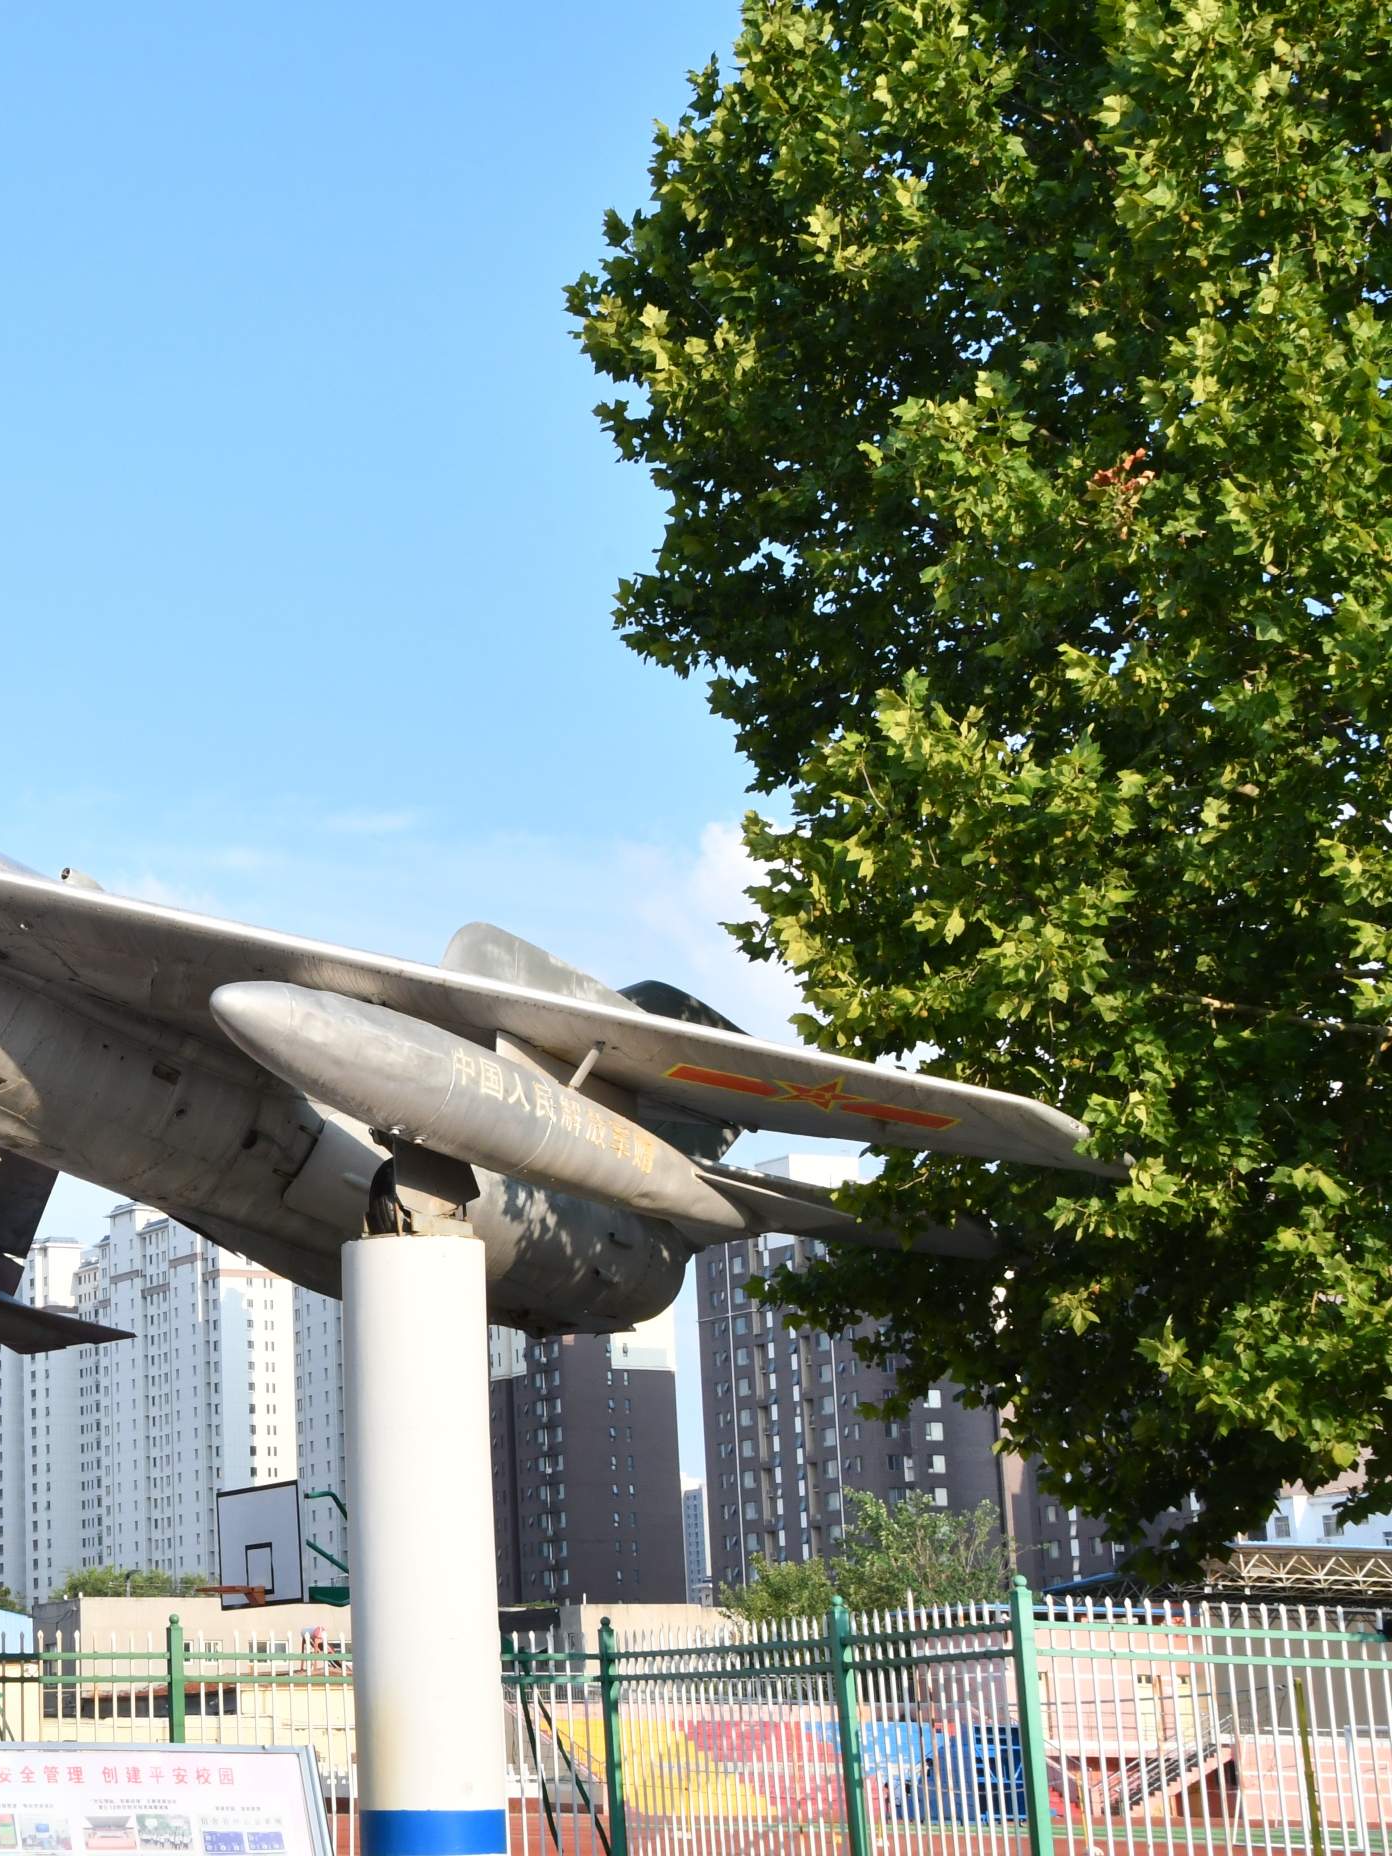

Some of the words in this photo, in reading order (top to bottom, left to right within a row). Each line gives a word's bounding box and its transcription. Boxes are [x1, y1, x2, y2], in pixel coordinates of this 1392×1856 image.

[102, 1767, 235, 1785] 创建平安校园
